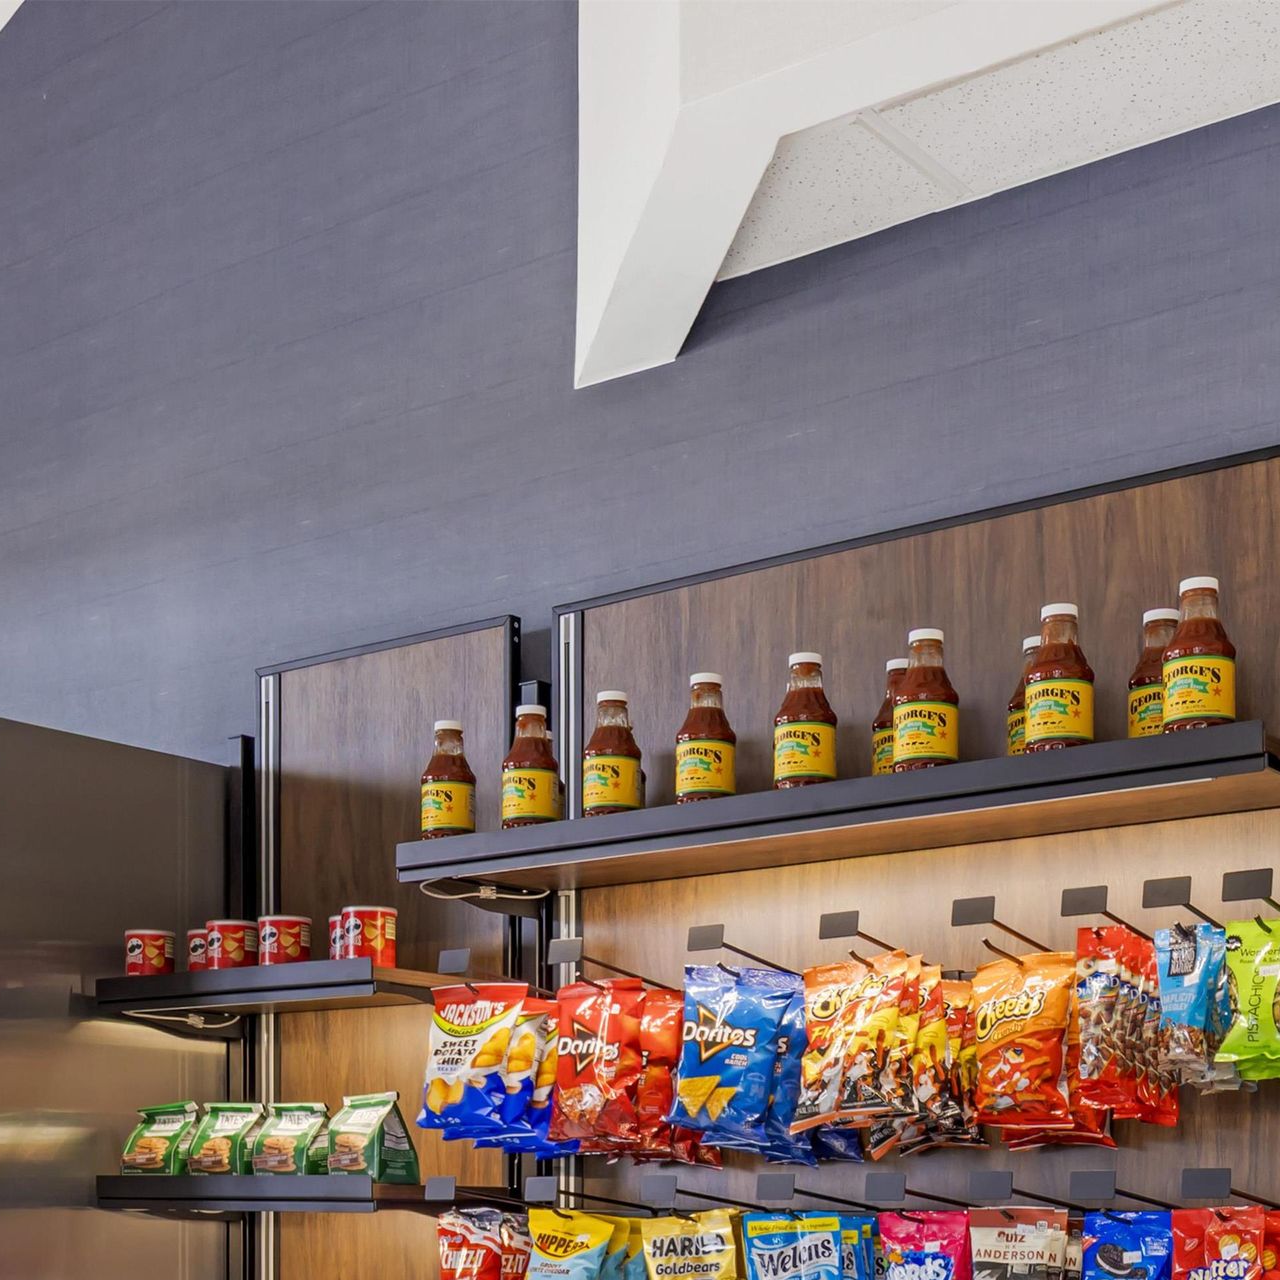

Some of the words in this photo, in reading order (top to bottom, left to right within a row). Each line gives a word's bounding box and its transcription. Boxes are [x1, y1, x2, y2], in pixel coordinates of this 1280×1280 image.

[440, 1001, 507, 1027] JACKSON'S
[977, 990, 1045, 1042] Cheetos
[683, 1021, 757, 1047] Doritos
[434, 1048, 476, 1056] POTATO
[441, 1040, 477, 1048] SWEET
[558, 1036, 619, 1060] Doritos
[974, 1248, 1045, 1261] ANDERSON
[656, 1262, 720, 1275] Goldbears
